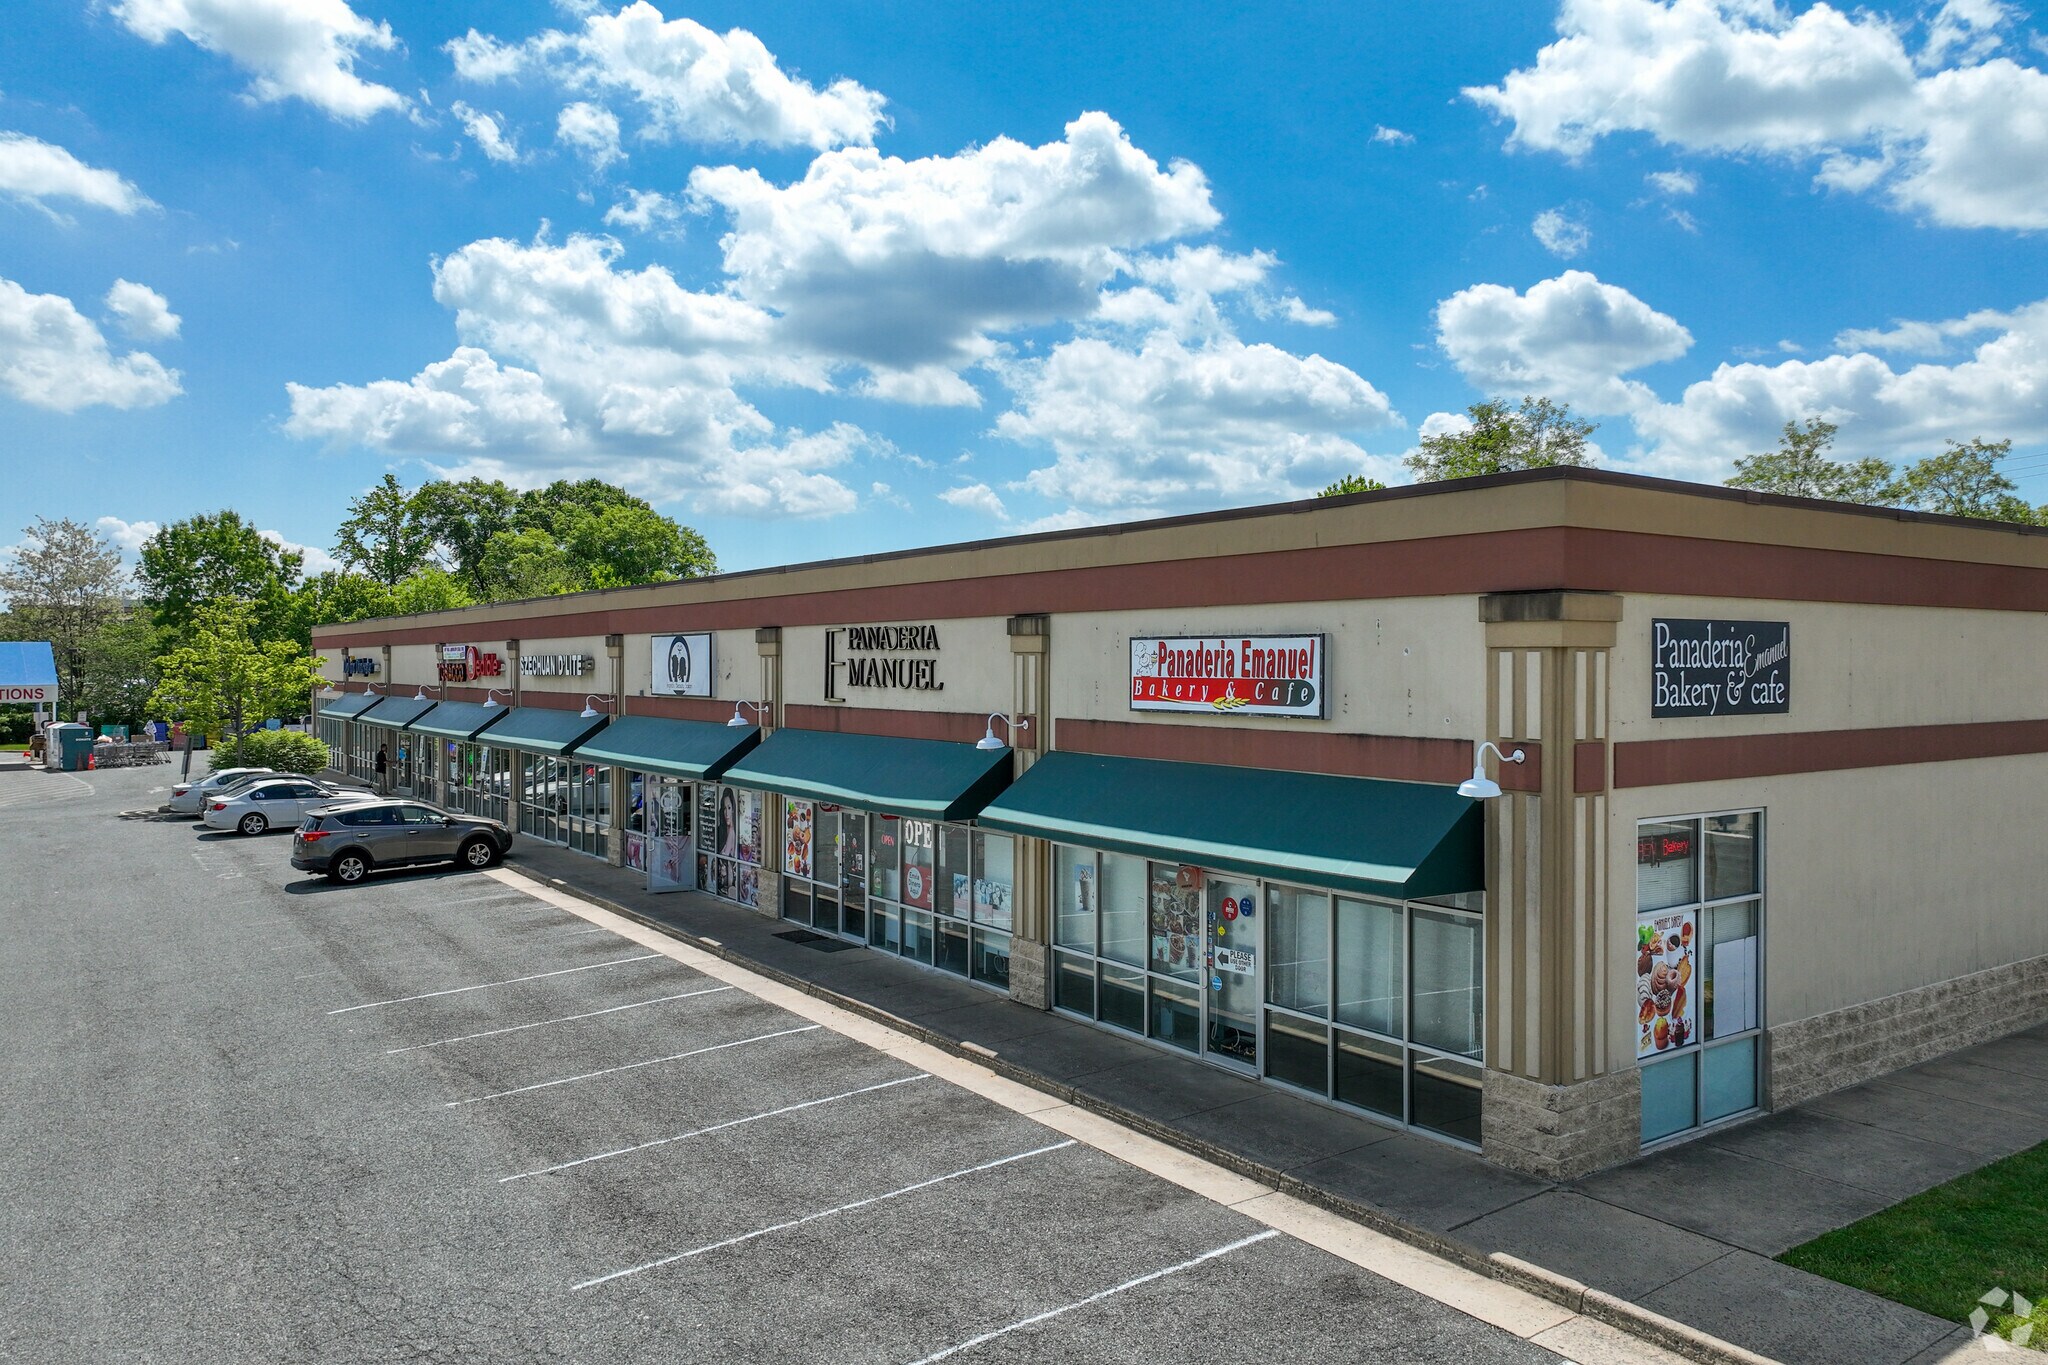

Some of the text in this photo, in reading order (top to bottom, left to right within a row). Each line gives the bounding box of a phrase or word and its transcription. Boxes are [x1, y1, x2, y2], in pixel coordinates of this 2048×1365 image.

[848, 625, 940, 650] PANADERIA
[1654, 622, 1788, 678] Panaderia Emanuel
[520, 654, 582, 676] SZECHUAN D'LITE
[1157, 639, 1315, 679] Panaderia Emanuel
[1134, 679, 1310, 705] Bakery & Cafe
[1655, 670, 1785, 715] Bakery & cafe
[881, 834, 895, 847] OPEN
[1663, 838, 1689, 856] Bakery
[1230, 950, 1251, 961] PLEASE
